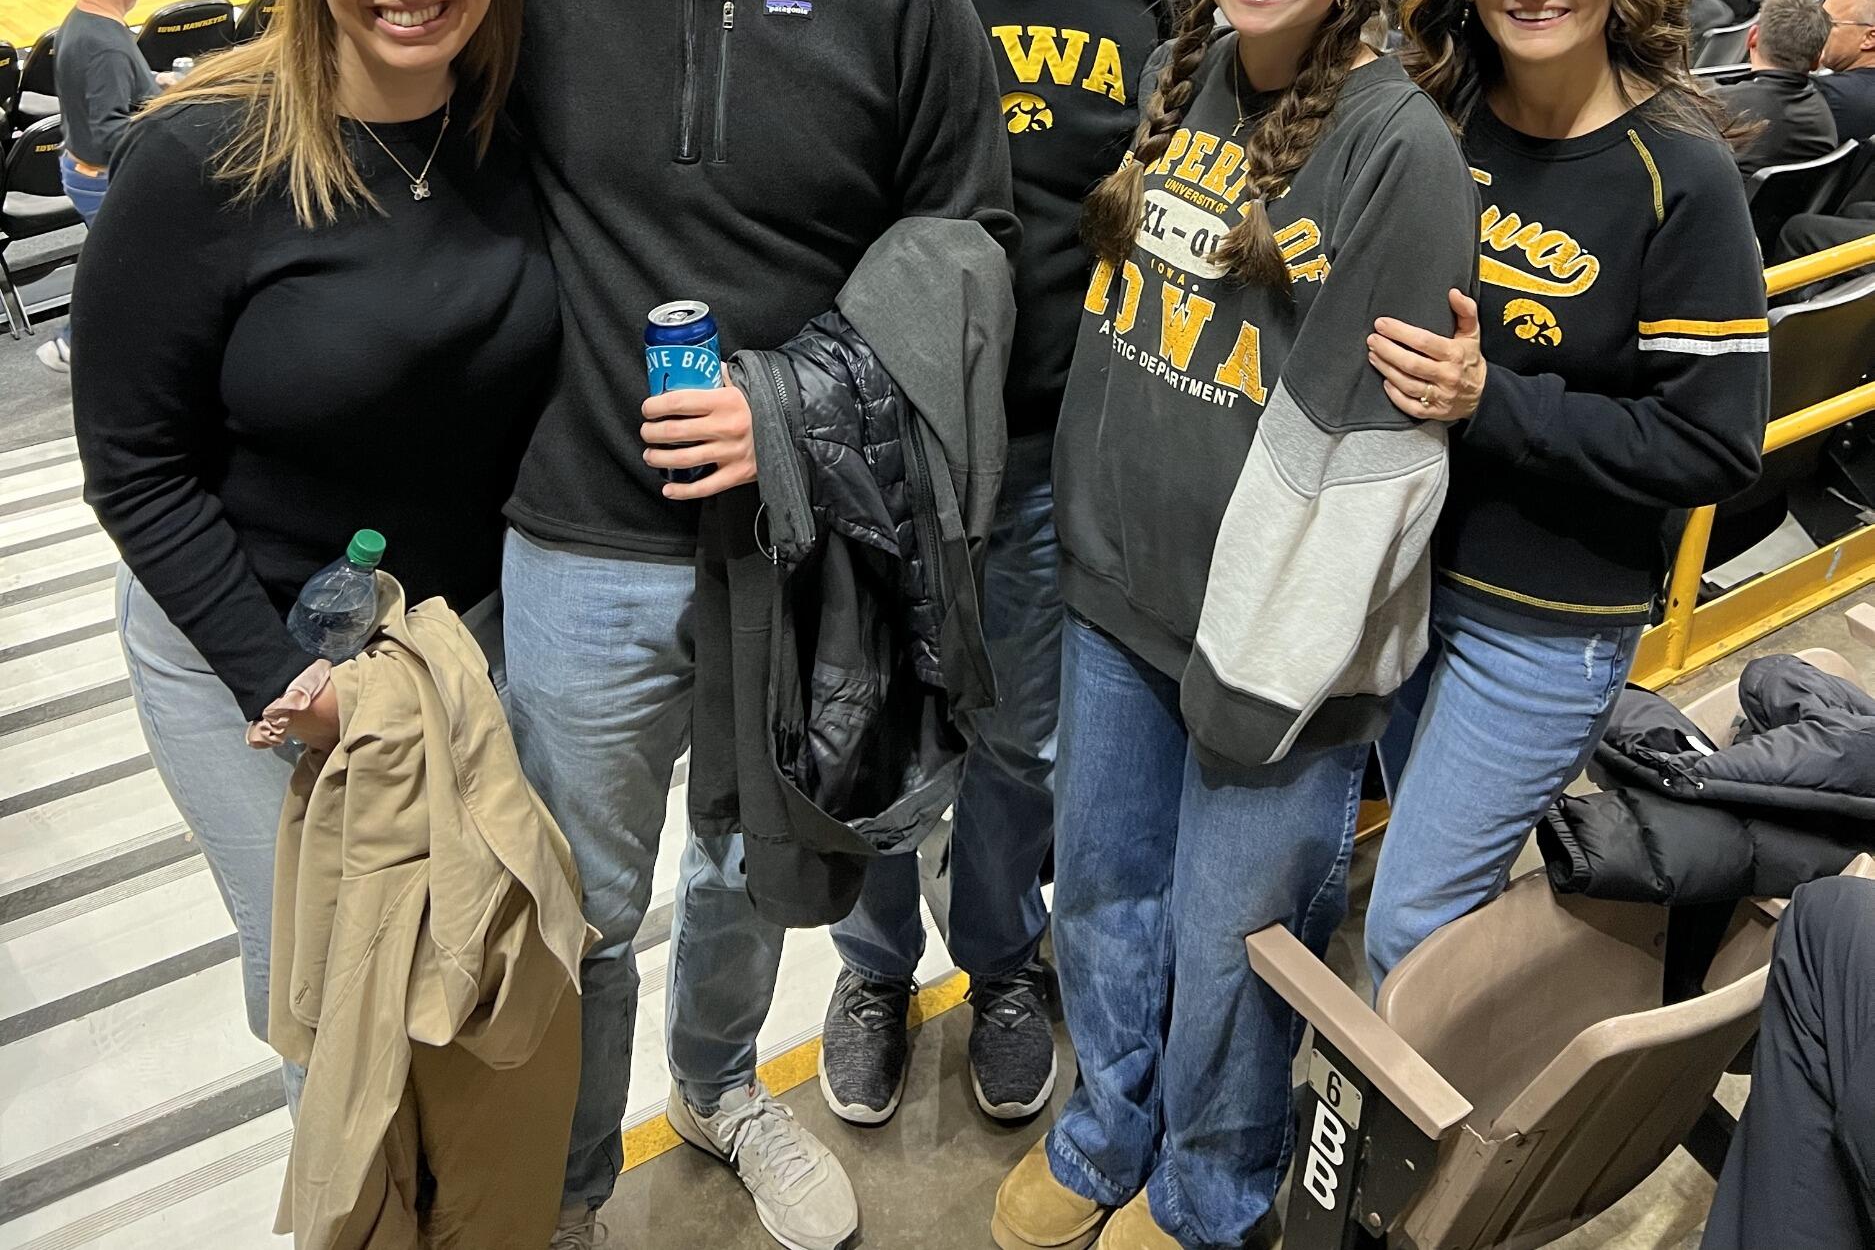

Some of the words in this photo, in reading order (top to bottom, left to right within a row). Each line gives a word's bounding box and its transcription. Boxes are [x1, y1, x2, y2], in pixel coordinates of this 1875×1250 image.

[991, 25, 1126, 105] WA
[1164, 178, 1217, 213] UNIVERSITY
[1214, 202, 1229, 215] OF
[1150, 258, 1186, 286] IOWA
[1139, 350, 1239, 409] DEPARTMENT
[1326, 1070, 1343, 1108] 6
